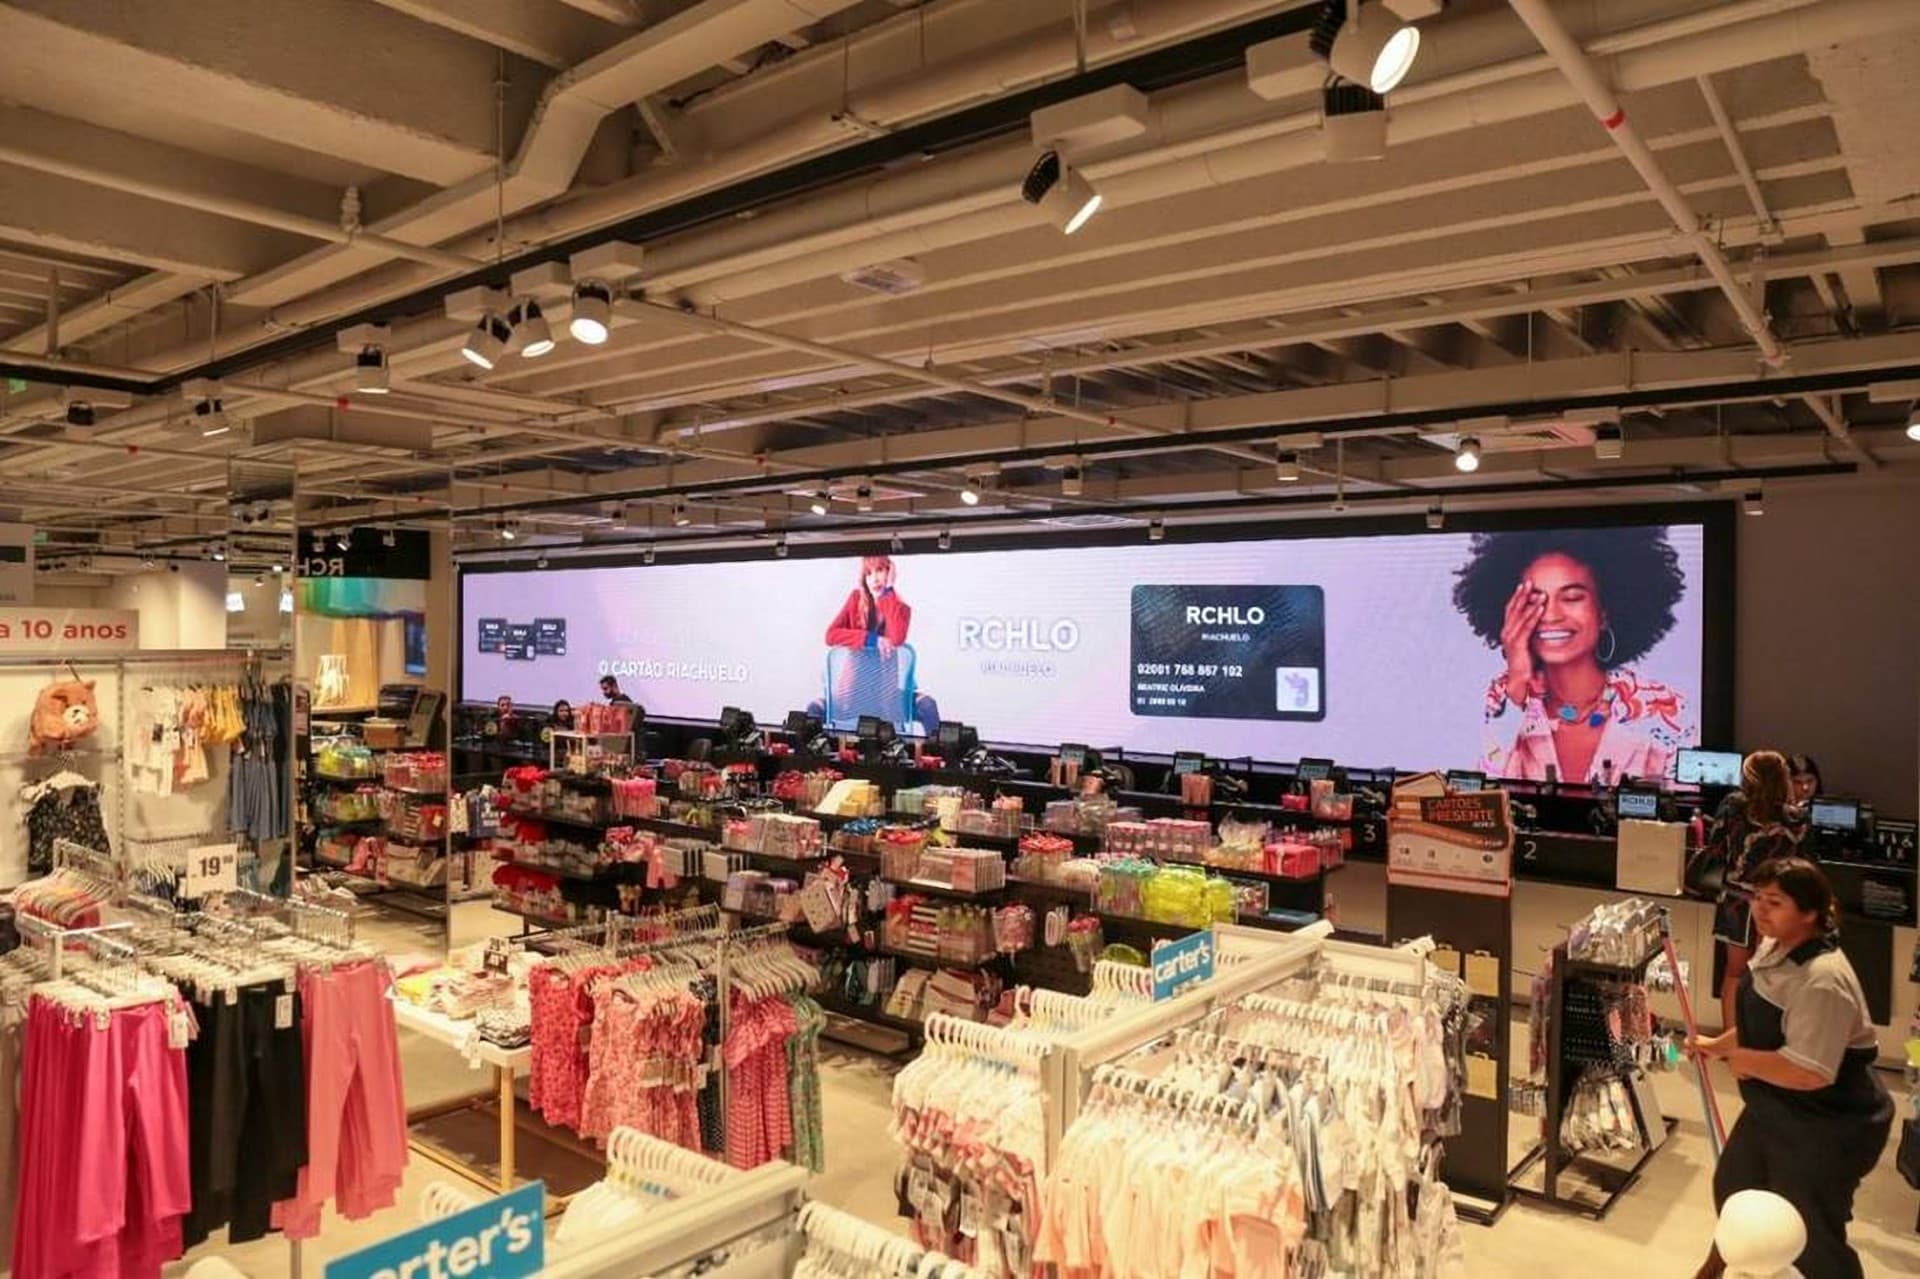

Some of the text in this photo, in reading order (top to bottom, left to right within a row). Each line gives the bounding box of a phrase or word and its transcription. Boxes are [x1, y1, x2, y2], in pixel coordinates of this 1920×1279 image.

[1186, 606, 1265, 625] RCHLO
[21, 620, 52, 639] 10
[64, 624, 127, 639] anos
[959, 617, 1079, 652] RCHLO
[599, 659, 609, 676] O
[1363, 824, 1377, 842] 3
[1523, 841, 1538, 860] 2
[199, 856, 221, 877] 19
[1154, 939, 1210, 984] carter's
